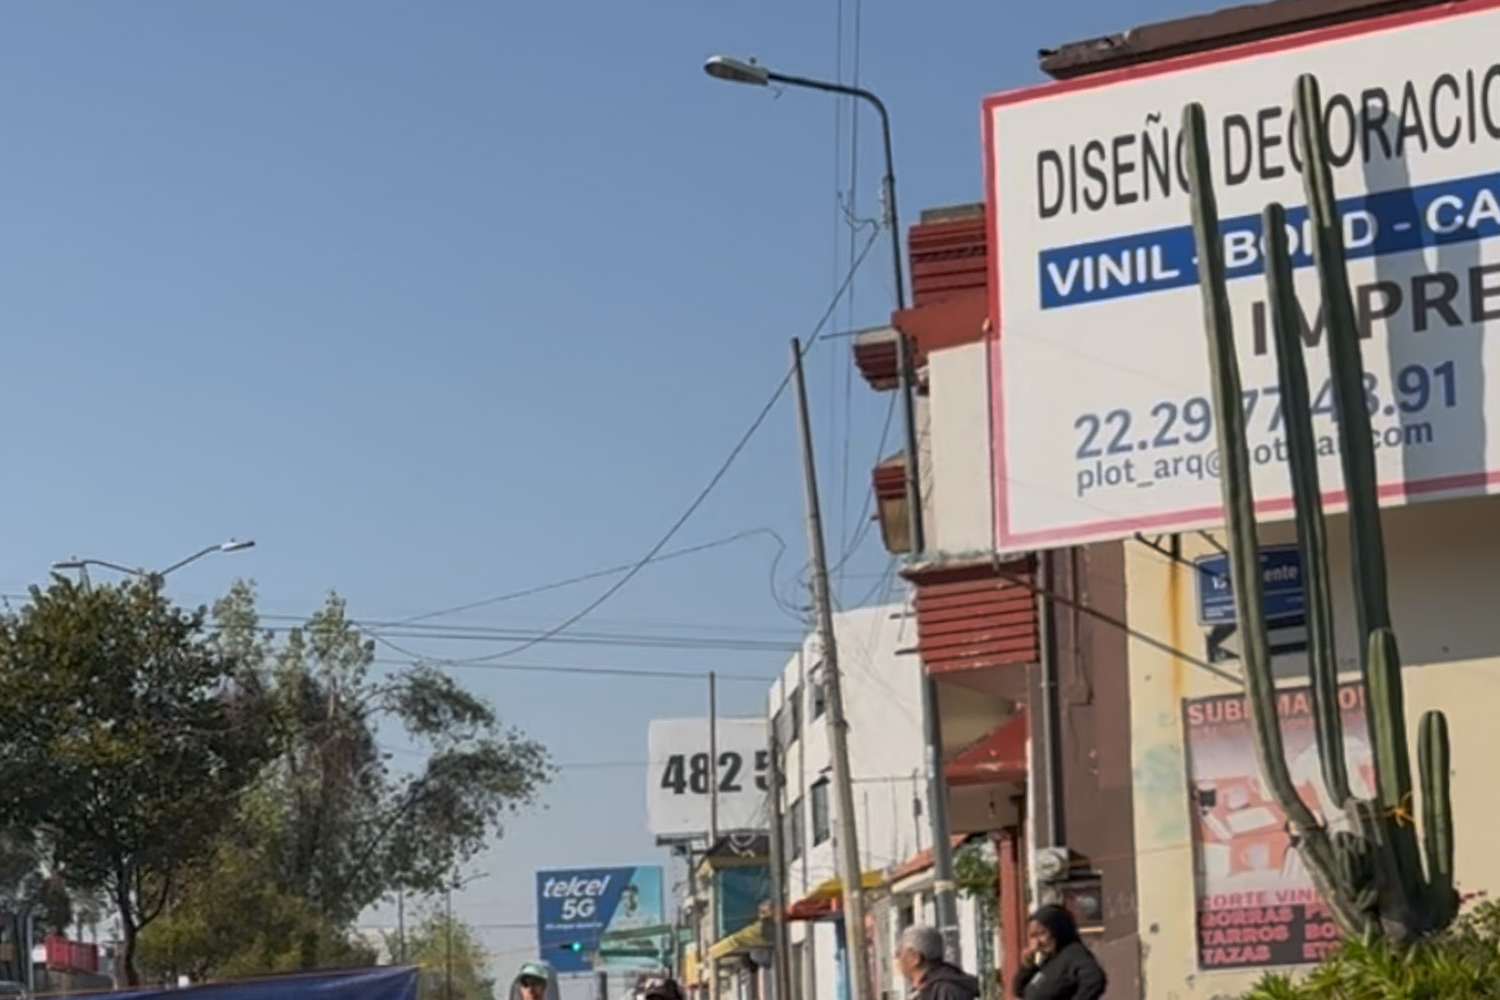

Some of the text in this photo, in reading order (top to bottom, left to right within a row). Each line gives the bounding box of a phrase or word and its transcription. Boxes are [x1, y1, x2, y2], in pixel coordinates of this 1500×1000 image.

[1047, 244, 1180, 298] VINIL
[660, 751, 743, 795] 482
[543, 874, 612, 898] telcel
[561, 898, 596, 921] 5G
[1201, 925, 1289, 945] TARROS
[1202, 945, 1271, 965] TAZAS
